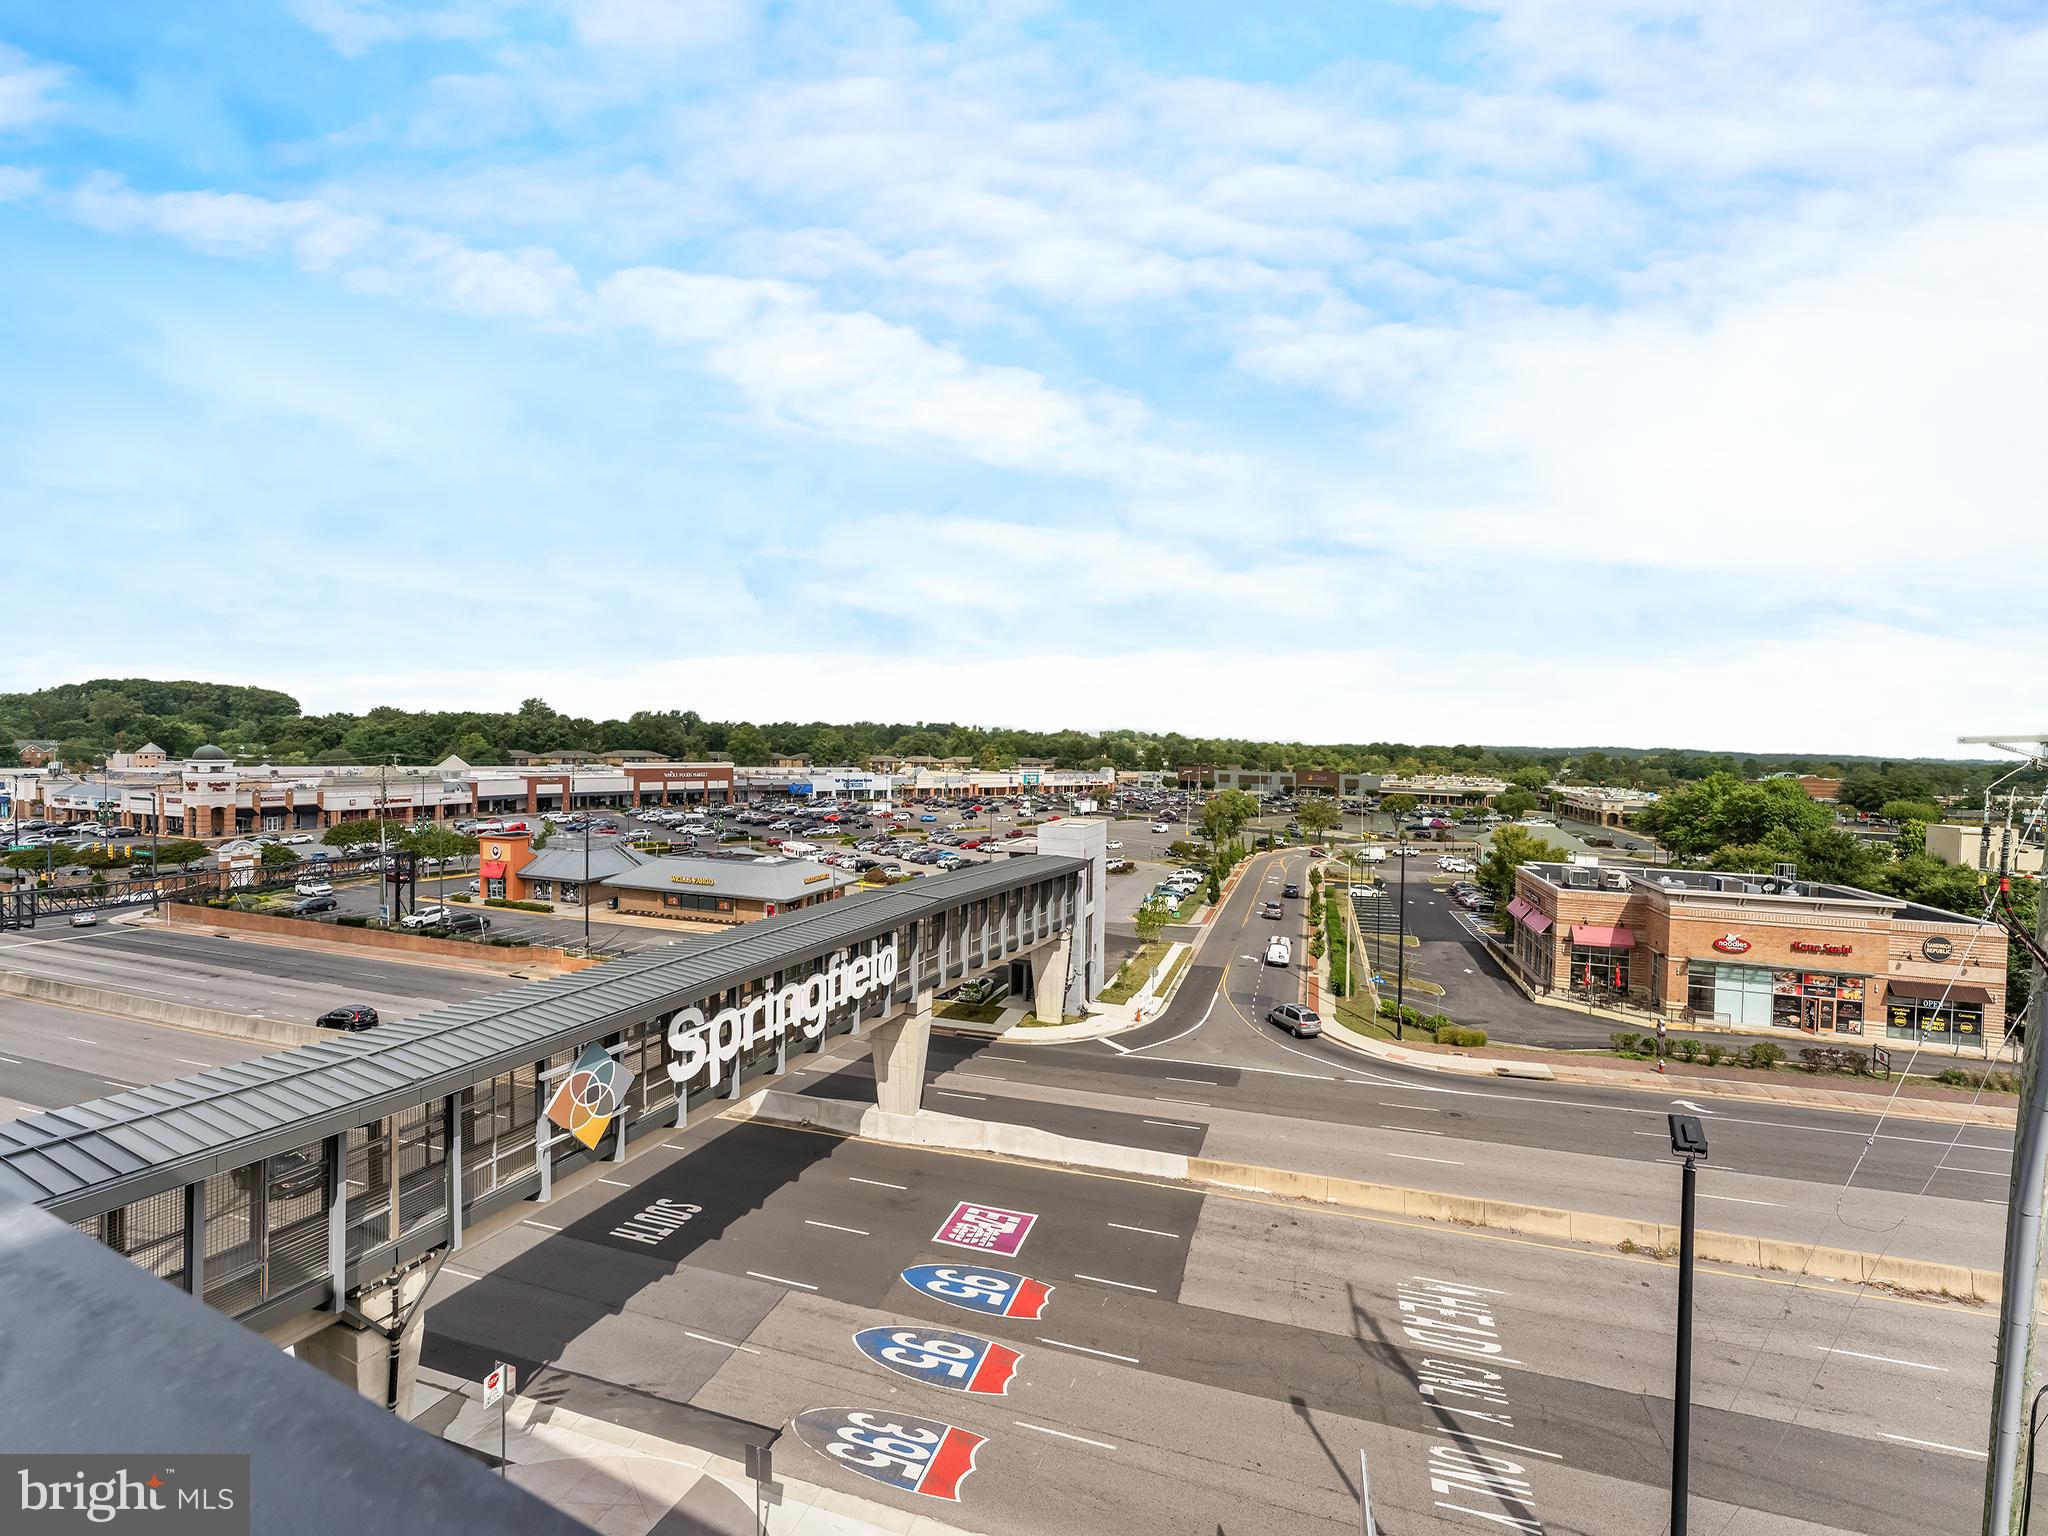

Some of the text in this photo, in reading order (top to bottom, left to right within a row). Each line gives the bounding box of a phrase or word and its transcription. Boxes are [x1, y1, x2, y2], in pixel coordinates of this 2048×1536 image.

[1718, 940, 1748, 949] noodles
[667, 932, 898, 1088] Springfield
[609, 1198, 703, 1245] SOUTH
[926, 1269, 1010, 1306] 95
[880, 1332, 975, 1378] 95
[826, 1412, 940, 1480] 395
[1428, 1446, 1543, 1536] ONLY
